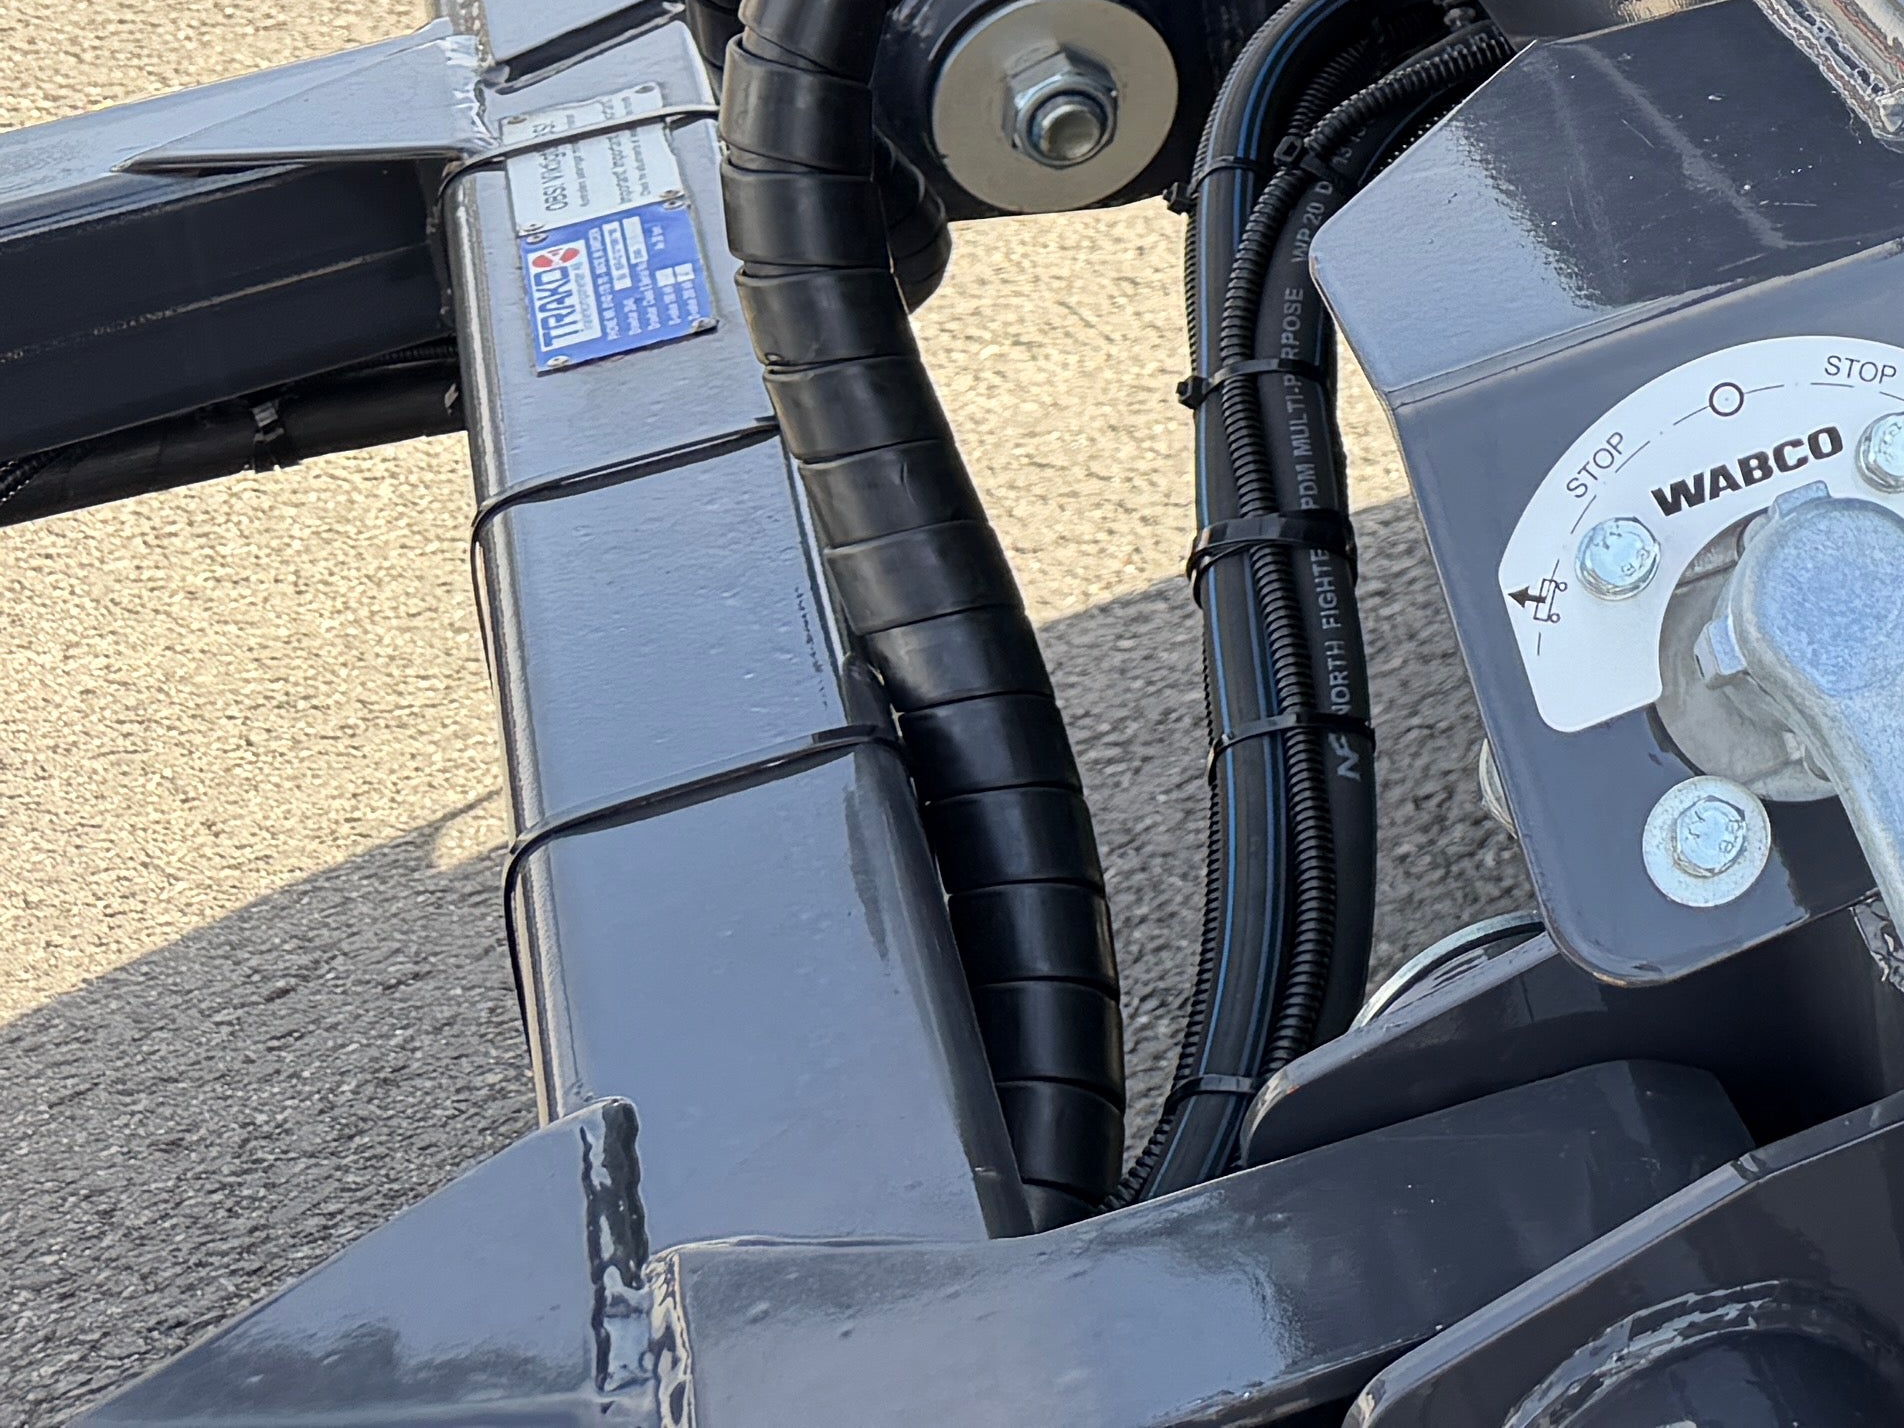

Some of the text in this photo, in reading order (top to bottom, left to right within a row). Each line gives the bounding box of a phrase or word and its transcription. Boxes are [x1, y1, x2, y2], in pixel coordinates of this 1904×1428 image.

[533, 266, 578, 348] TRAKO
[1281, 287, 1315, 455] MULTI-PRPOSE
[1824, 355, 1897, 384] STOP
[1299, 463, 1320, 511] PDM
[1567, 432, 1624, 499] STOP
[1651, 425, 1843, 517] WABCO
[1310, 547, 1342, 630] FIGHTE
